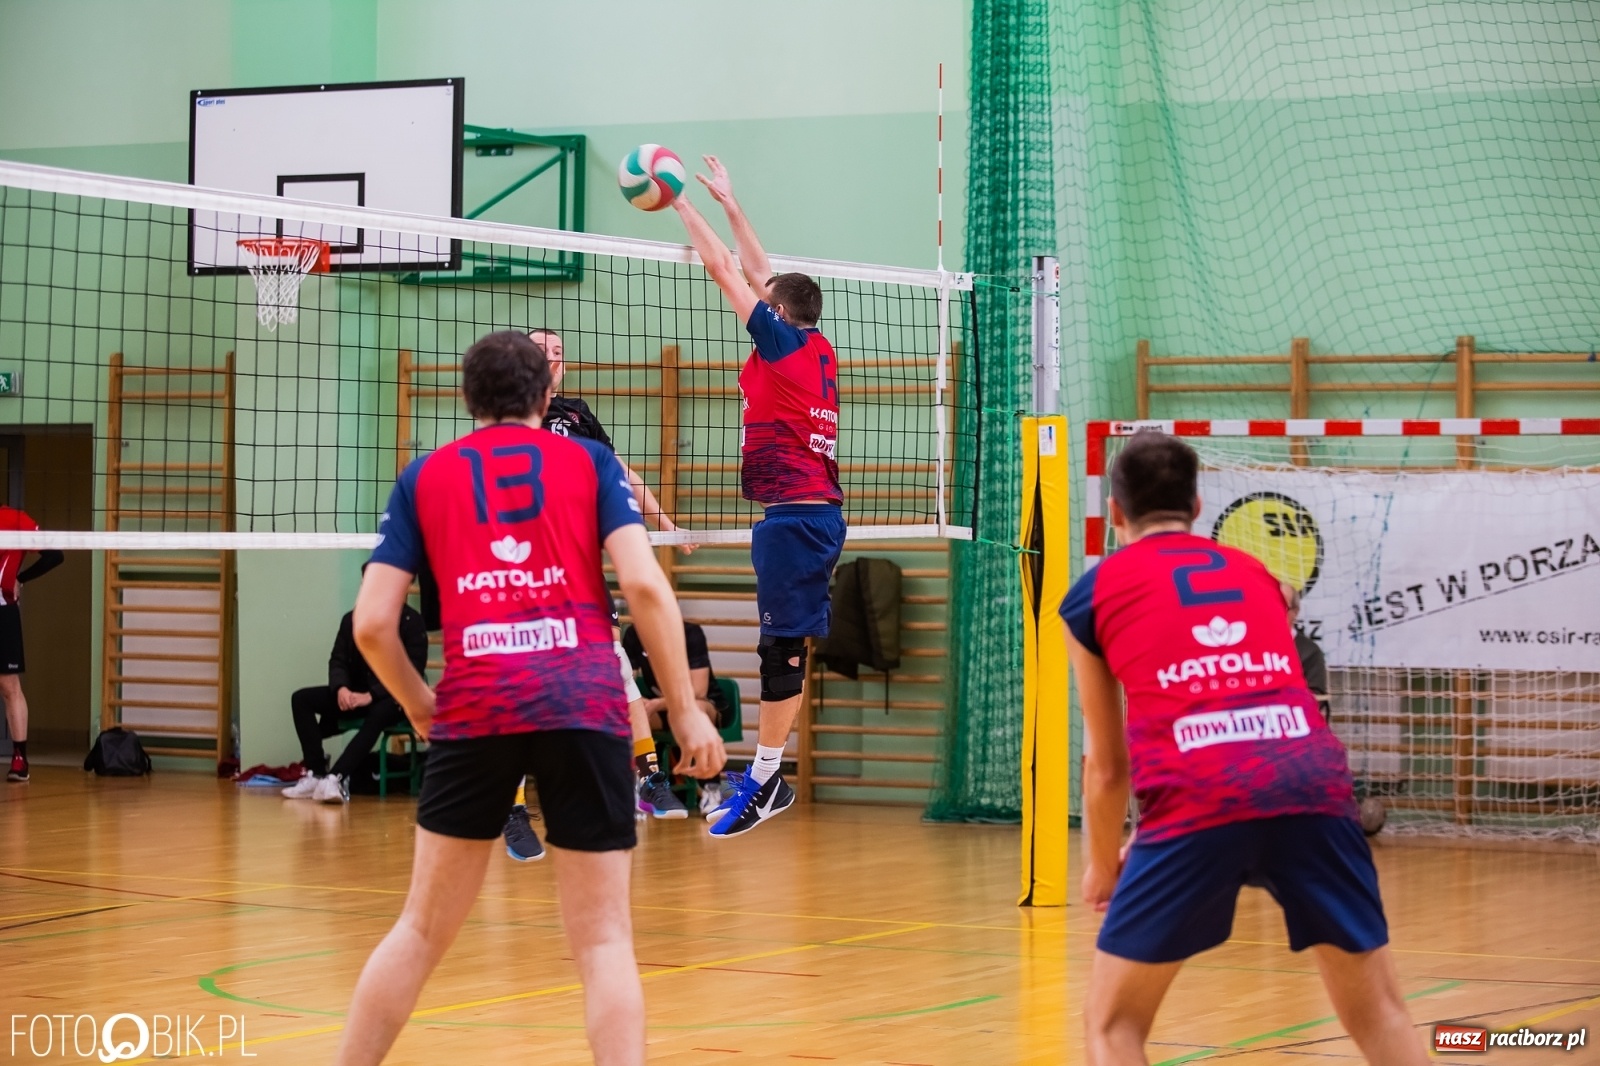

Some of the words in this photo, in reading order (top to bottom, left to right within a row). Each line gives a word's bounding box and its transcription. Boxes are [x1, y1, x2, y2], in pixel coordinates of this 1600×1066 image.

[458, 443, 545, 525] 13
[457, 565, 568, 595] KATOLIK
[480, 589, 551, 604] GROUP
[1158, 548, 1245, 608] 2
[1348, 584, 1427, 633] JEST
[1436, 570, 1467, 603] W
[465, 619, 571, 652] nowiny.pl
[1156, 651, 1292, 690] KATOLIK
[1189, 674, 1274, 694] GROUP
[1178, 705, 1304, 745] nowiny.pl
